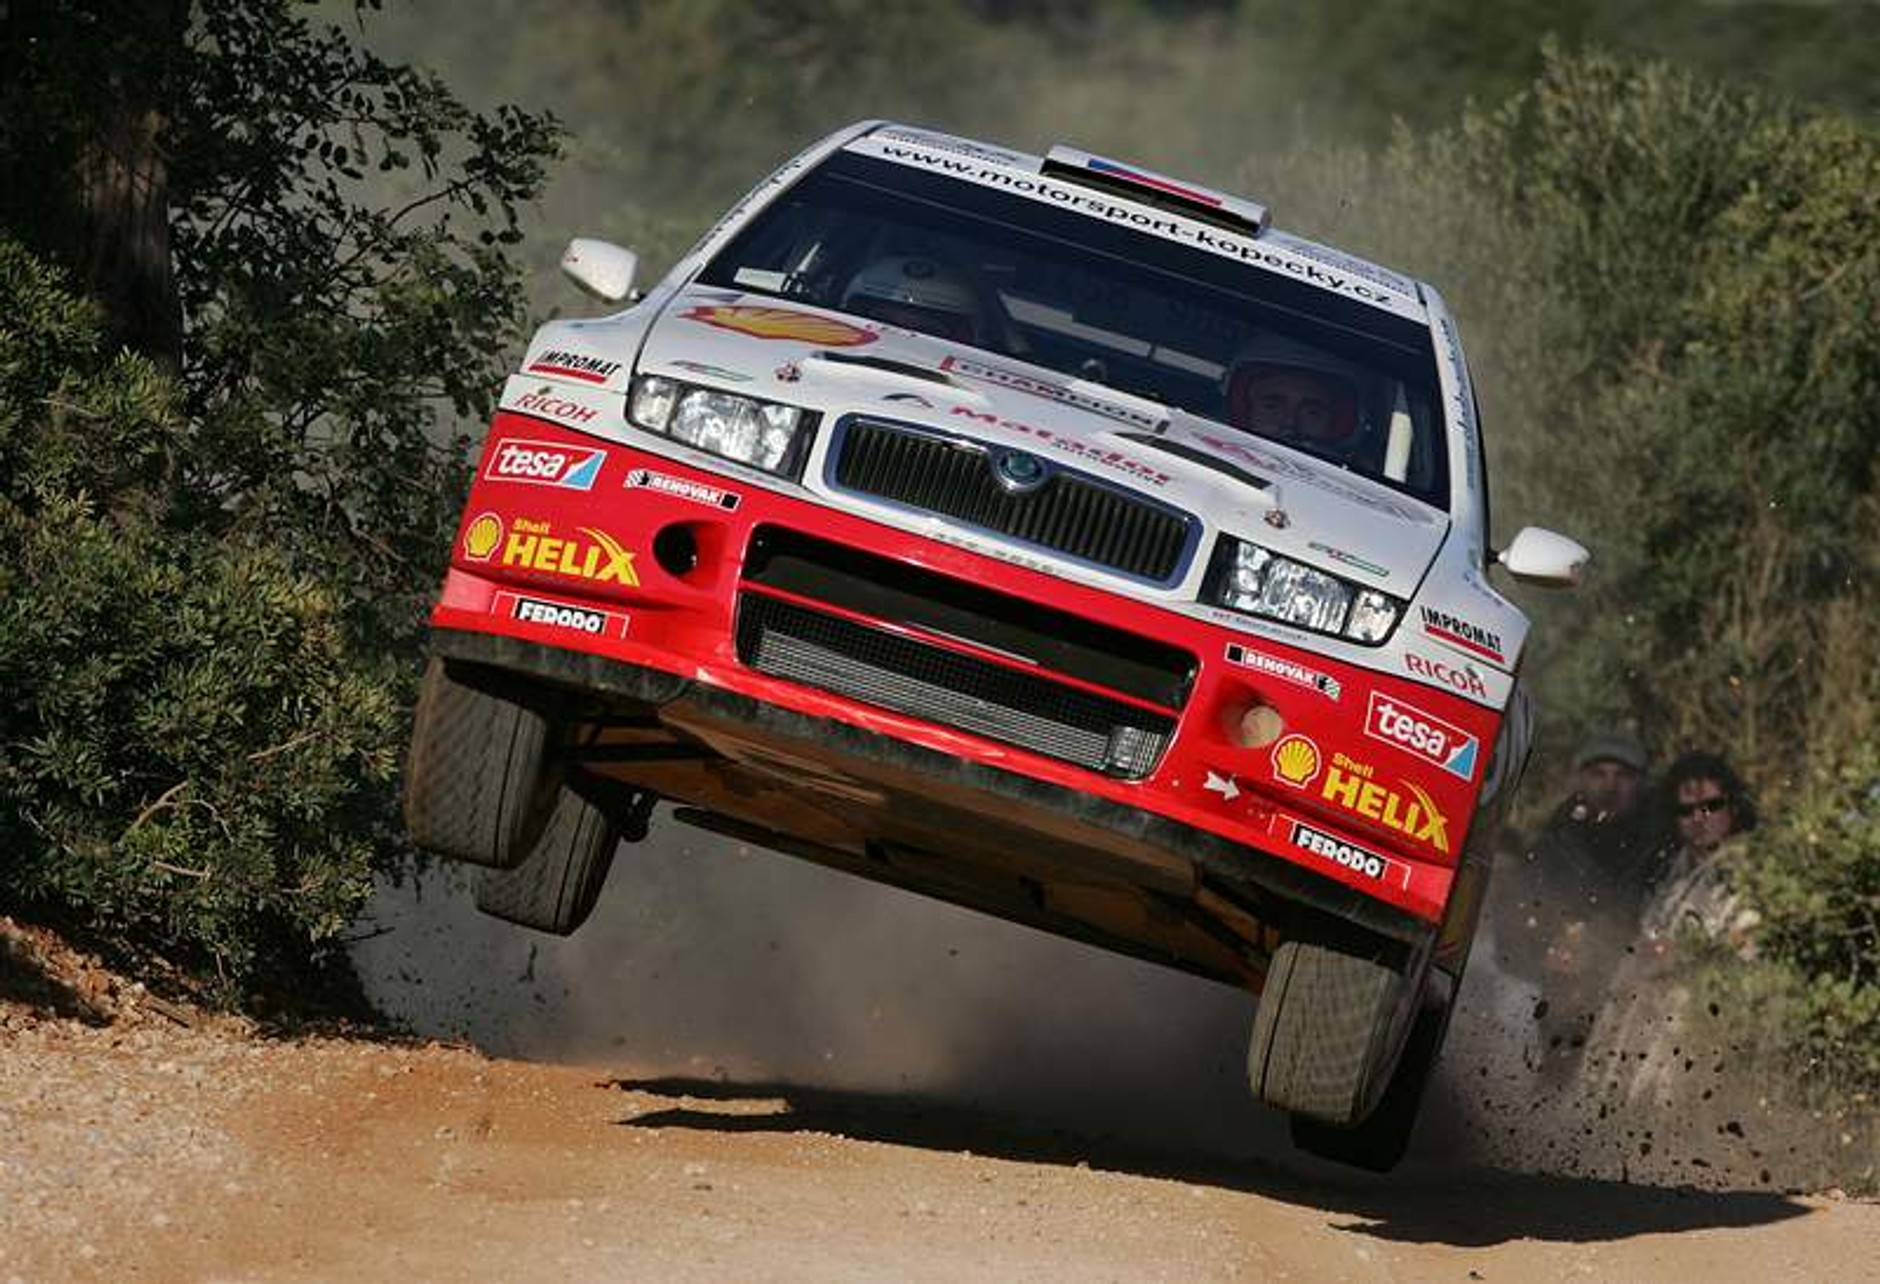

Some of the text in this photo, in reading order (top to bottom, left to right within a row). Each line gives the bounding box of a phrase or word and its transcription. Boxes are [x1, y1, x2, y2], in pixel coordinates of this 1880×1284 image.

[883, 146, 1392, 306] www.motorsport-kopecky.cz
[537, 350, 622, 375] IMPROMAT
[515, 392, 598, 422] RICOH
[959, 362, 1153, 425] CHAMPION
[498, 444, 566, 478] tesa
[651, 475, 721, 503] RENOVAK
[514, 518, 551, 534] Shell
[502, 527, 640, 587] HELIX
[1420, 605, 1504, 652] IMPROMAT
[1244, 652, 1317, 684] RENOVAK
[1405, 653, 1487, 698] RICOH
[1376, 703, 1447, 757] tesa
[1333, 752, 1375, 778] Shell
[1320, 765, 1450, 854] HELIX
[1297, 828, 1381, 878] FERODO
